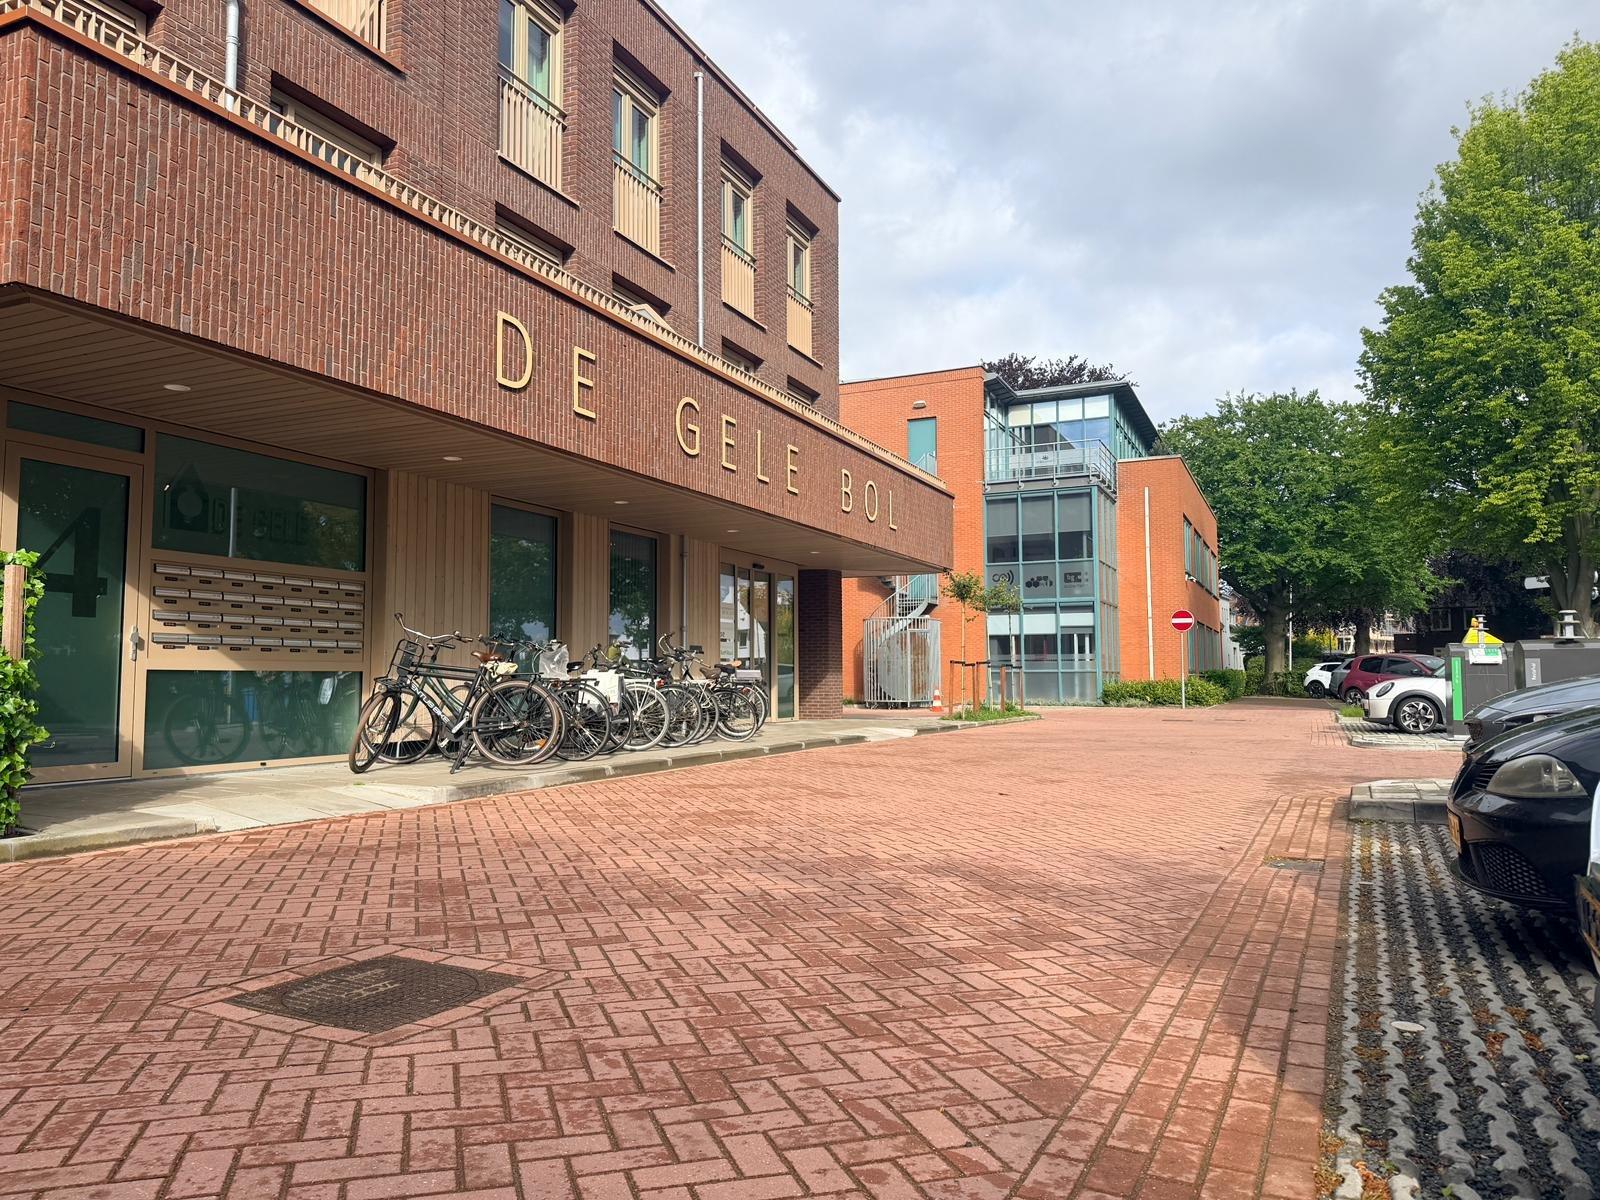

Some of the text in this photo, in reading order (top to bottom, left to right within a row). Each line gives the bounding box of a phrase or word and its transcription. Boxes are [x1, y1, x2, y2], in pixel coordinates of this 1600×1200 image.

[496, 310, 897, 530] DE GELE BOL
[34, 507, 108, 618] 4
